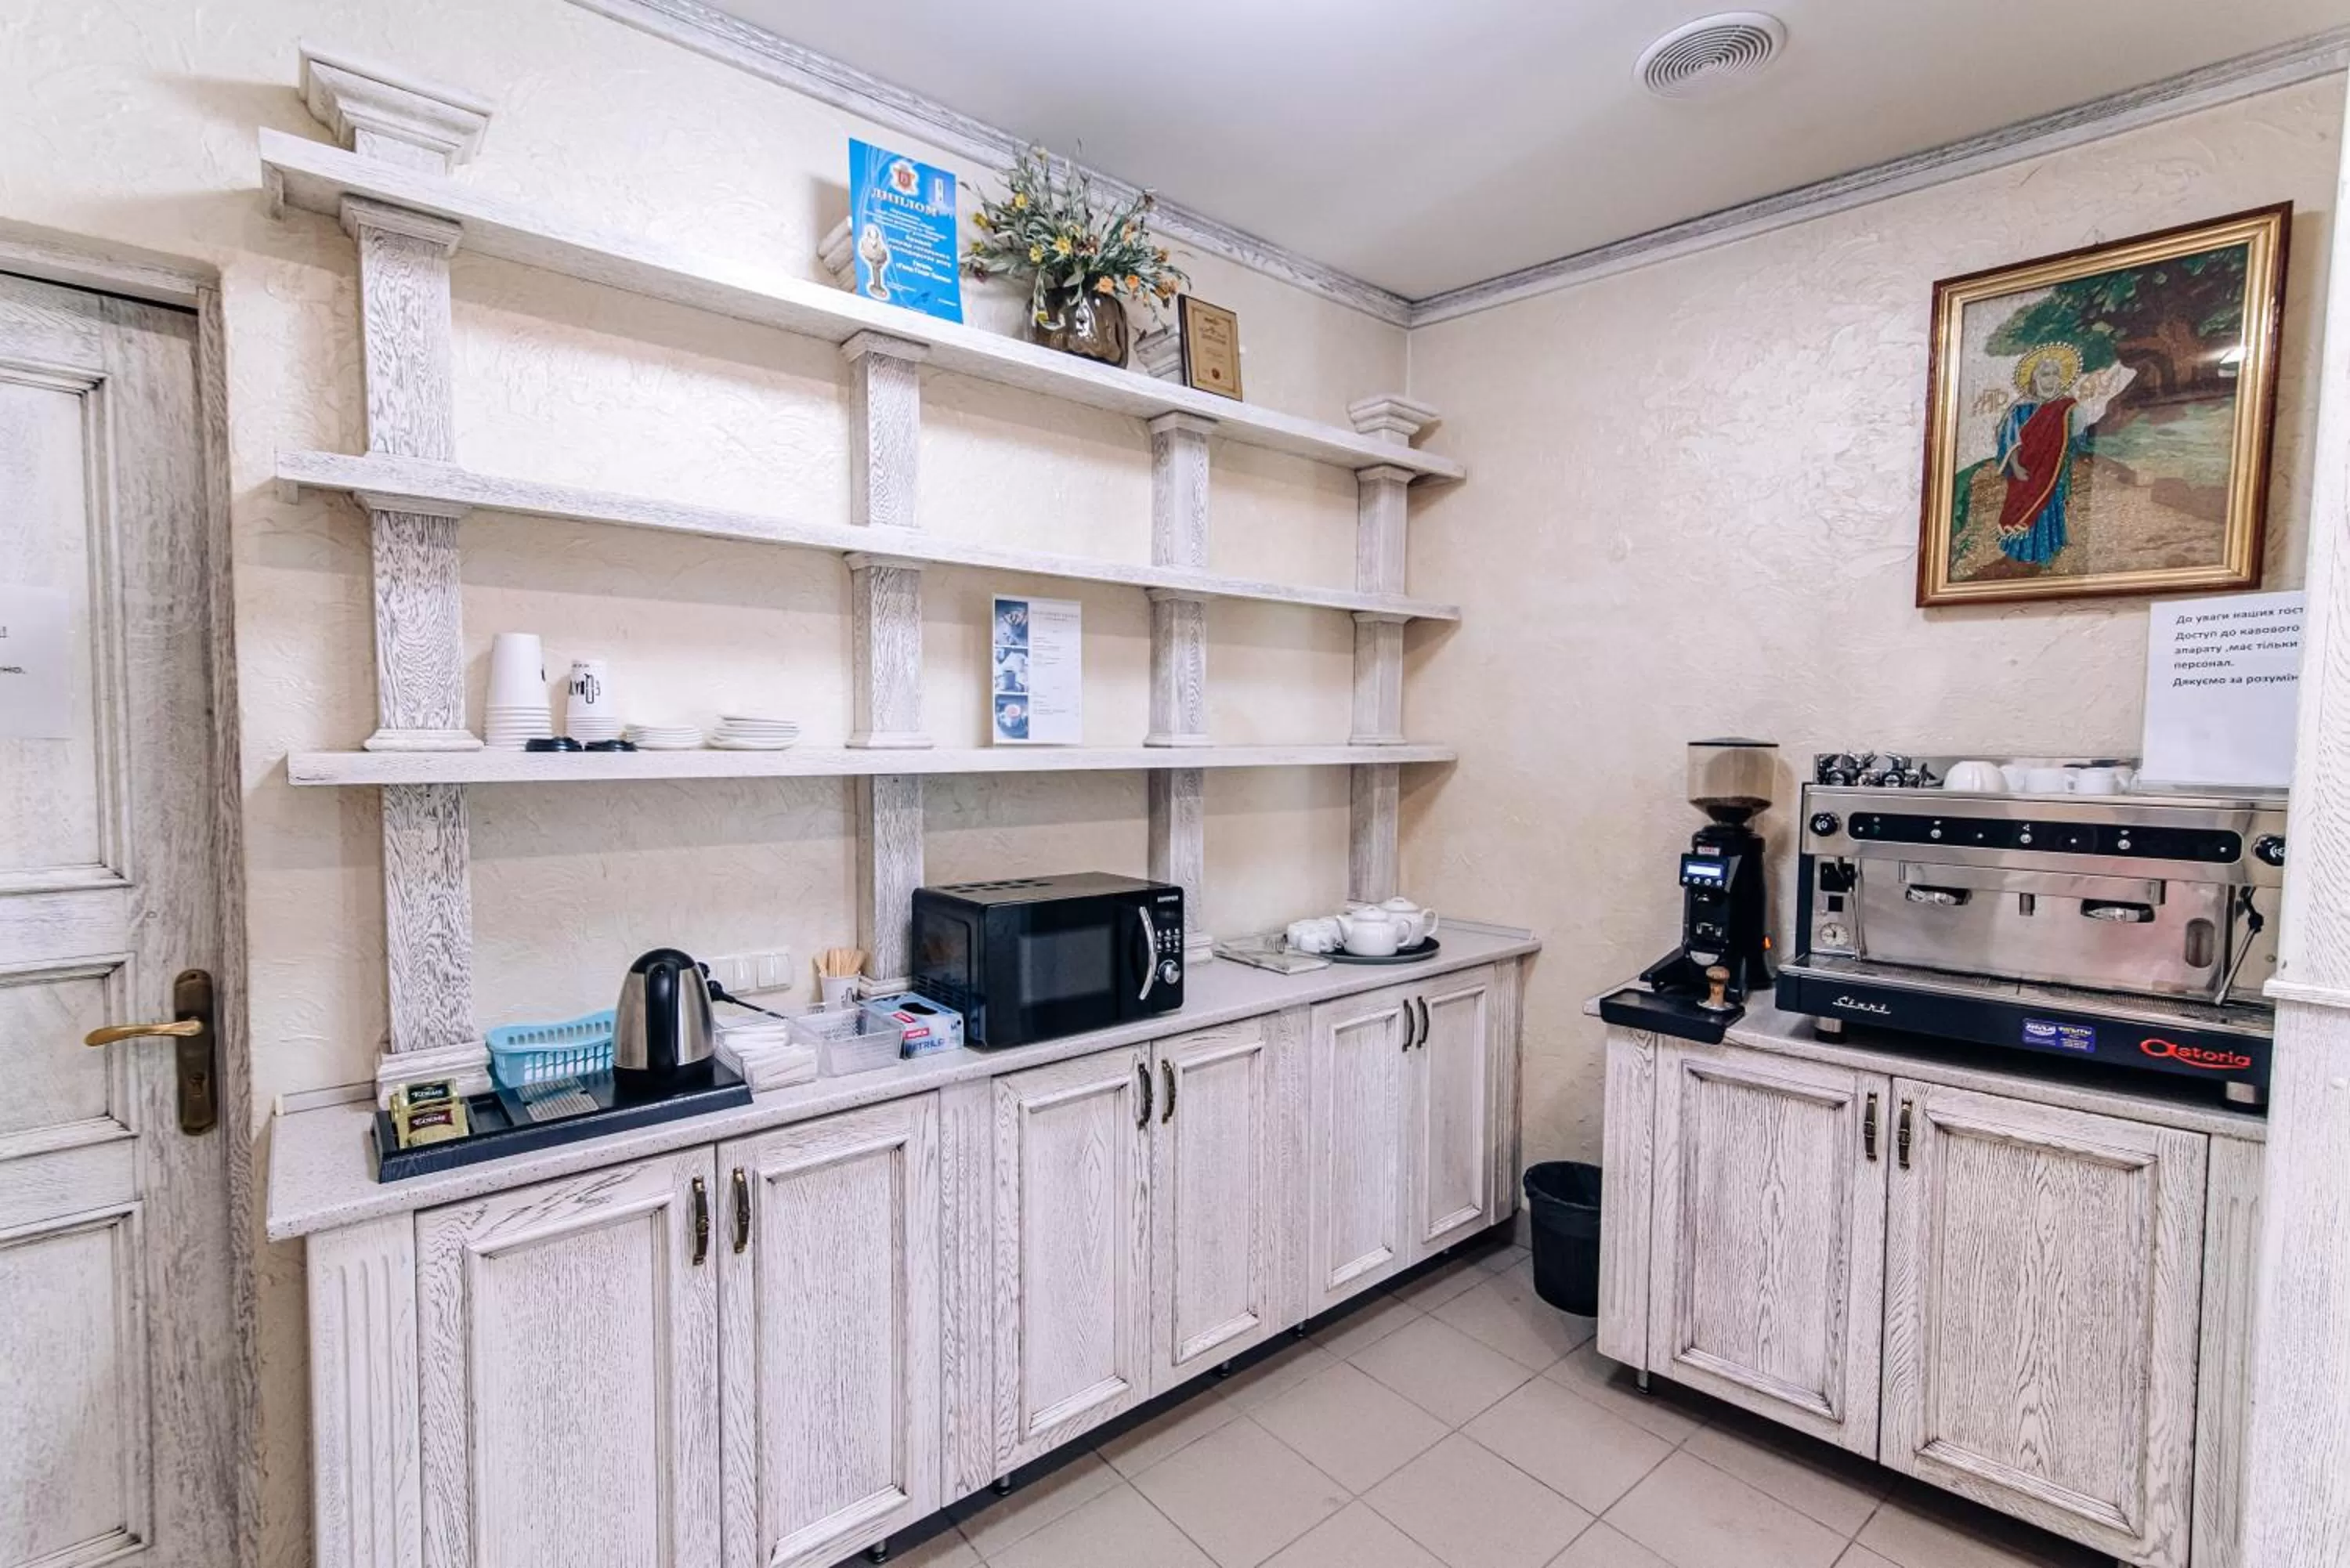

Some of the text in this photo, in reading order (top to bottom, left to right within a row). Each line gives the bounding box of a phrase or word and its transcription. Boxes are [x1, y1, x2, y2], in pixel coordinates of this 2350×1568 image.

[871, 188, 938, 217] ДИПЛОМ
[2176, 615, 2193, 625] До
[2196, 613, 2229, 625] уваги
[2175, 625, 2300, 641] Доступ до кавового
[2175, 645, 2222, 655] апарату
[2256, 641, 2298, 650] тільки
[2174, 659, 2235, 670] персонал.
[2172, 677, 2226, 687] Дякуємо
